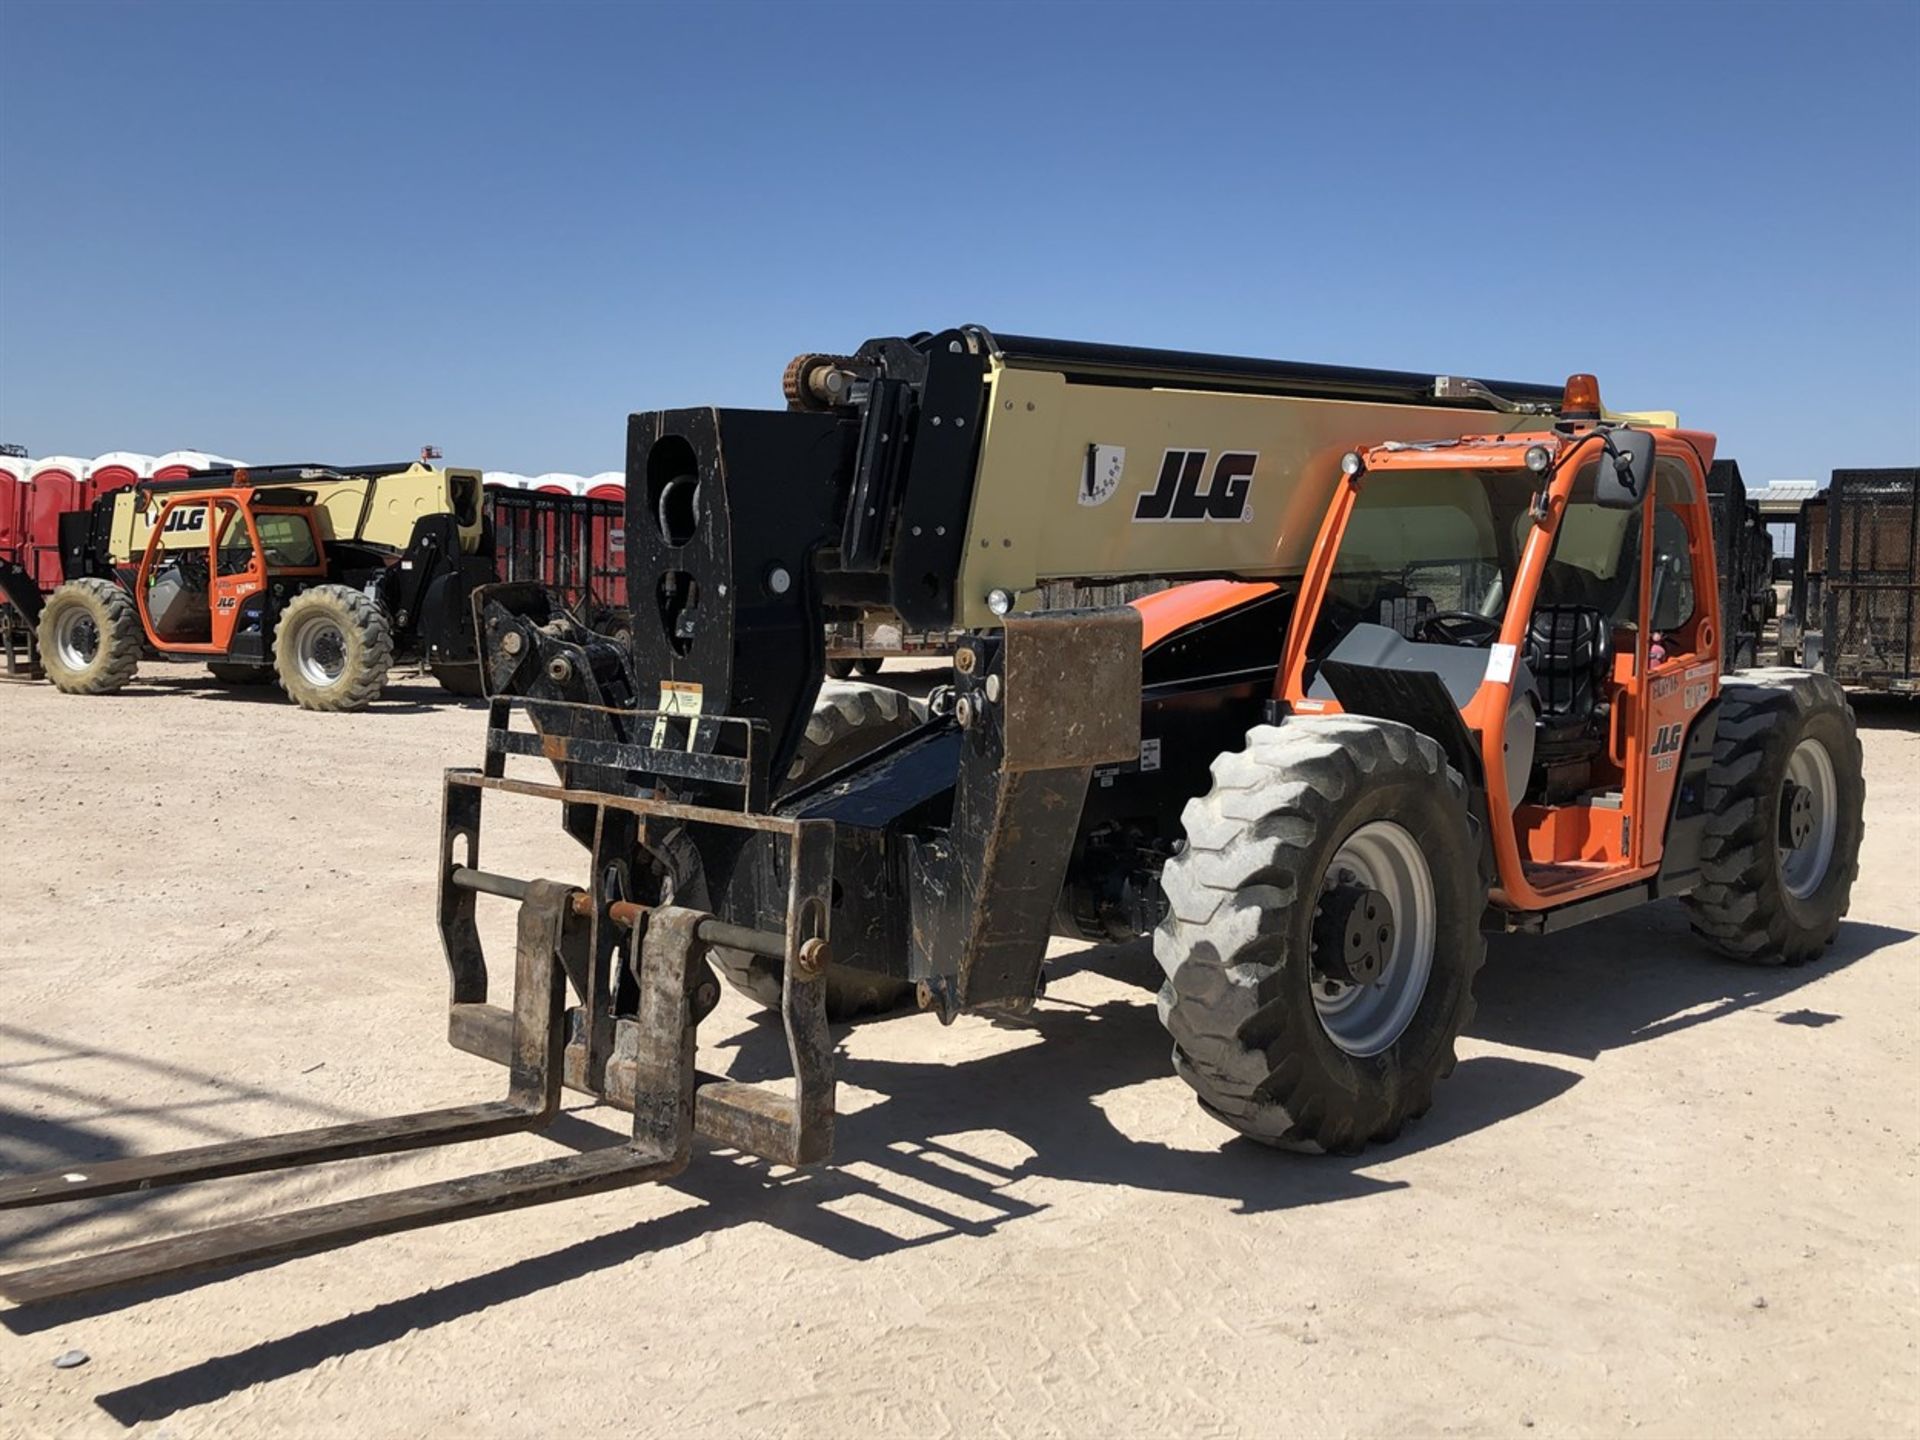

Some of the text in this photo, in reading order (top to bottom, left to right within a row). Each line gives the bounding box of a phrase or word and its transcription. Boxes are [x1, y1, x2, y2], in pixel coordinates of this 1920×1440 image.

[1134, 450, 1258, 520] JLG
[164, 508, 206, 532] JLG
[216, 597, 236, 608] JLG
[1650, 722, 1682, 756] JLG
